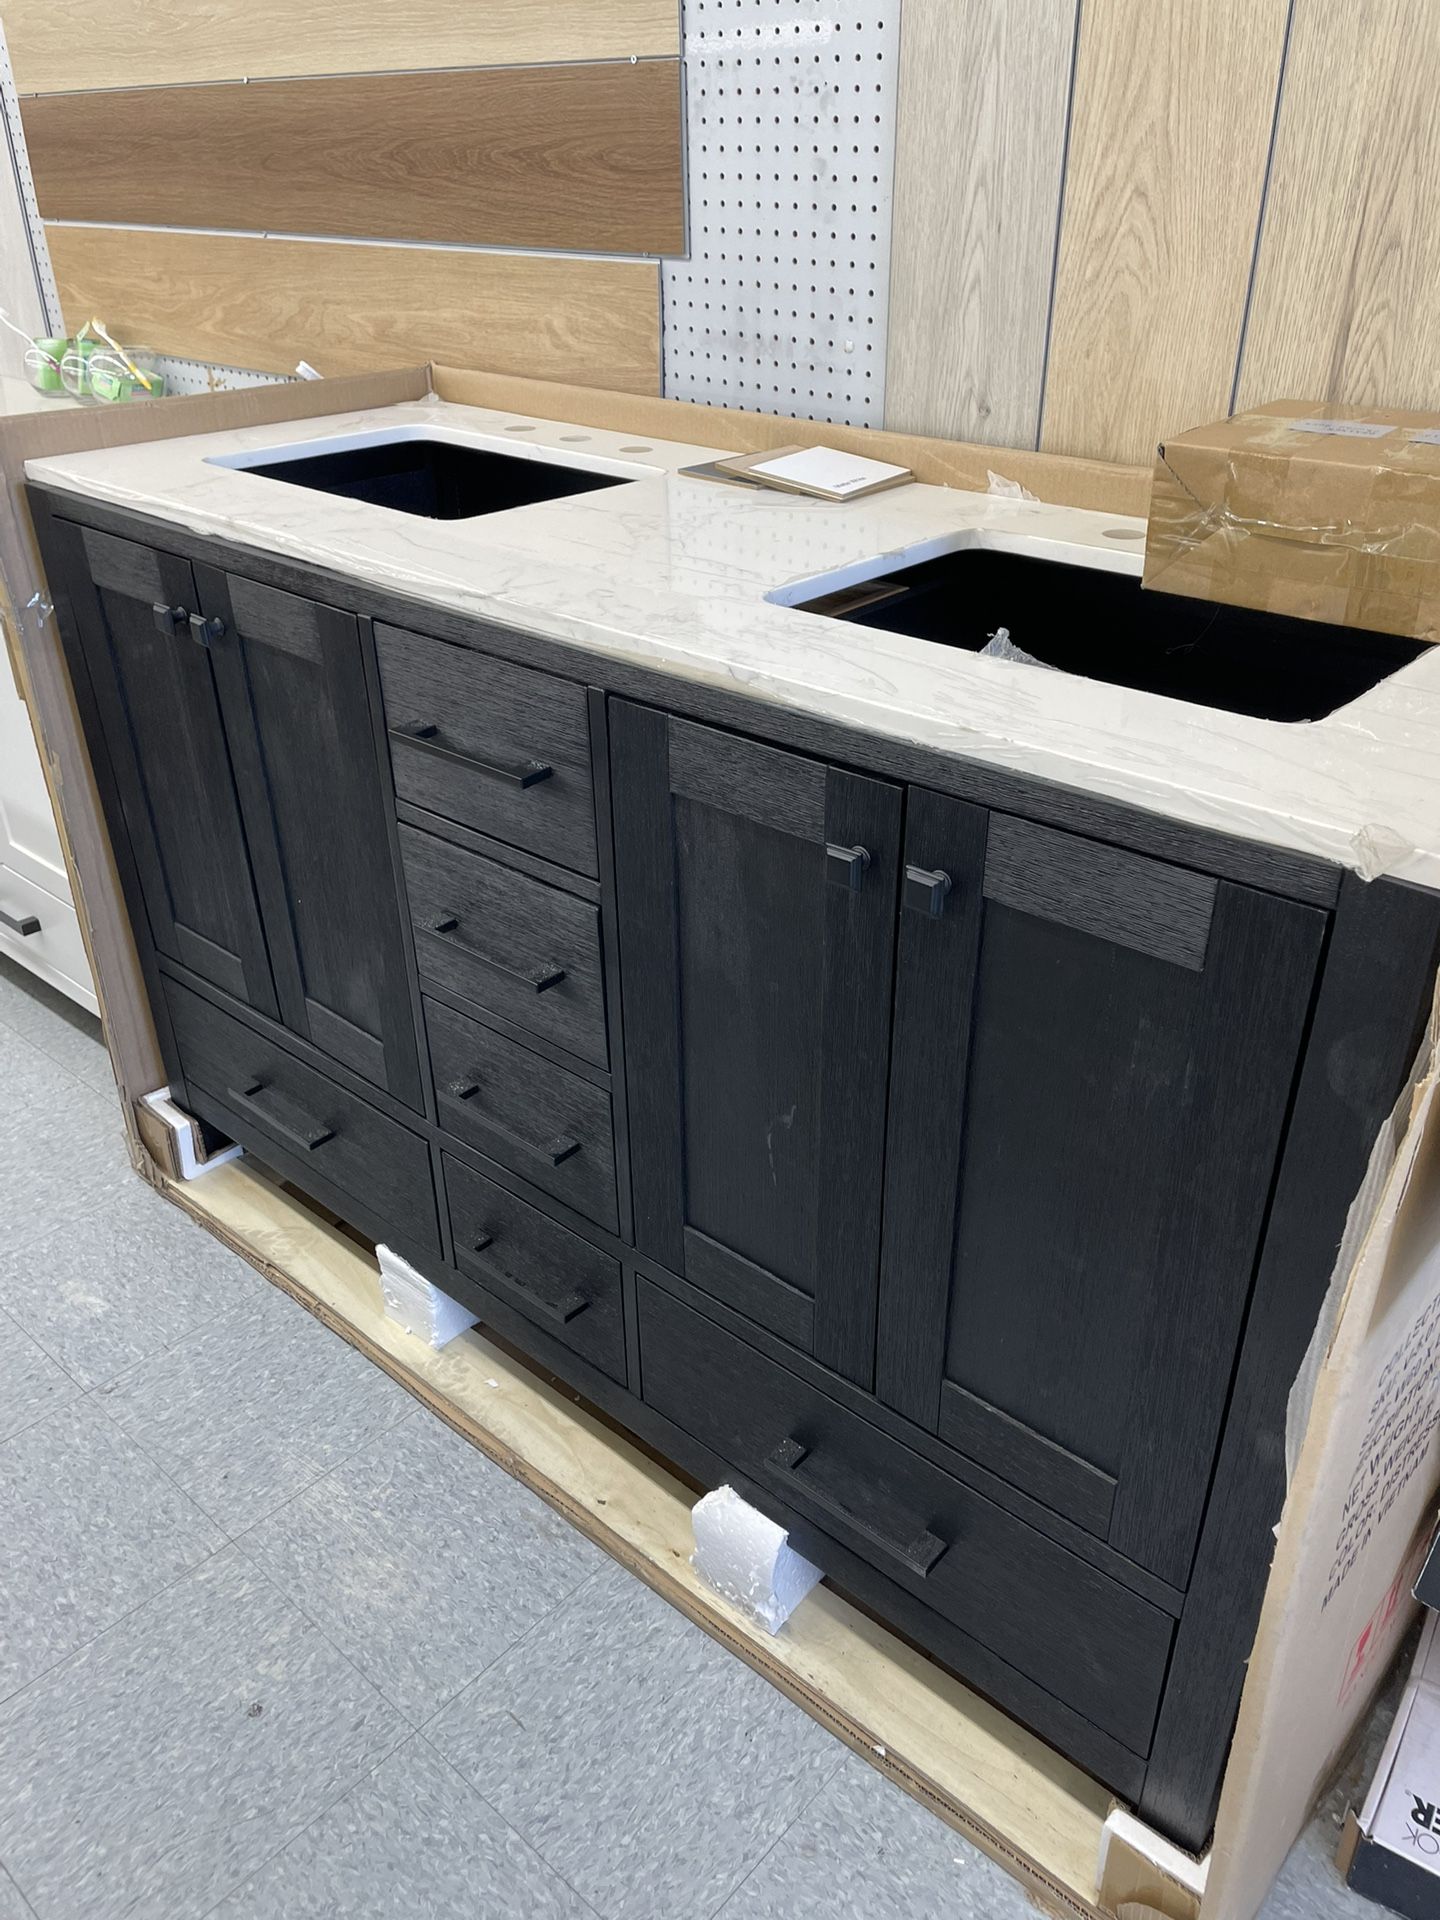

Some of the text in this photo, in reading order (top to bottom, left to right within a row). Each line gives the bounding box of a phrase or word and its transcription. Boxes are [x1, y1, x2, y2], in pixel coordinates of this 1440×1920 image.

[1321, 1440, 1429, 1613] MADE IN VIETNAM
[1336, 1473, 1381, 1551] GROSS
[1342, 1467, 1368, 1521] NET
